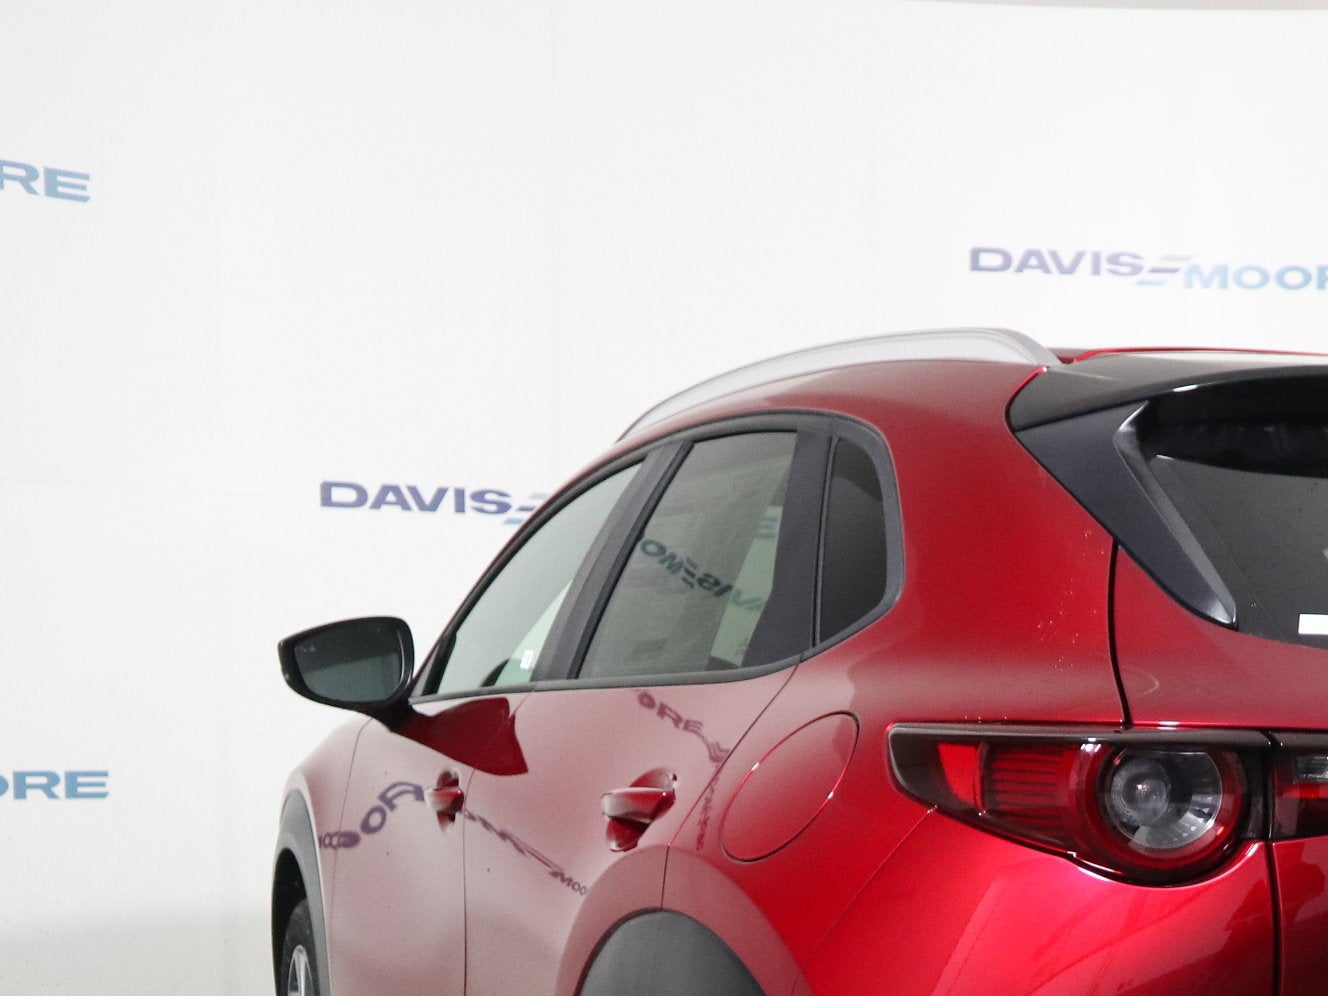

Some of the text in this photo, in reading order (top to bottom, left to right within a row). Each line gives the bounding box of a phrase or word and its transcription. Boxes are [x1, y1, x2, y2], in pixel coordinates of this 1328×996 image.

[969, 246, 1144, 276] DAVIS
[319, 480, 512, 515] DAVIS
[0, 769, 109, 800] RE
